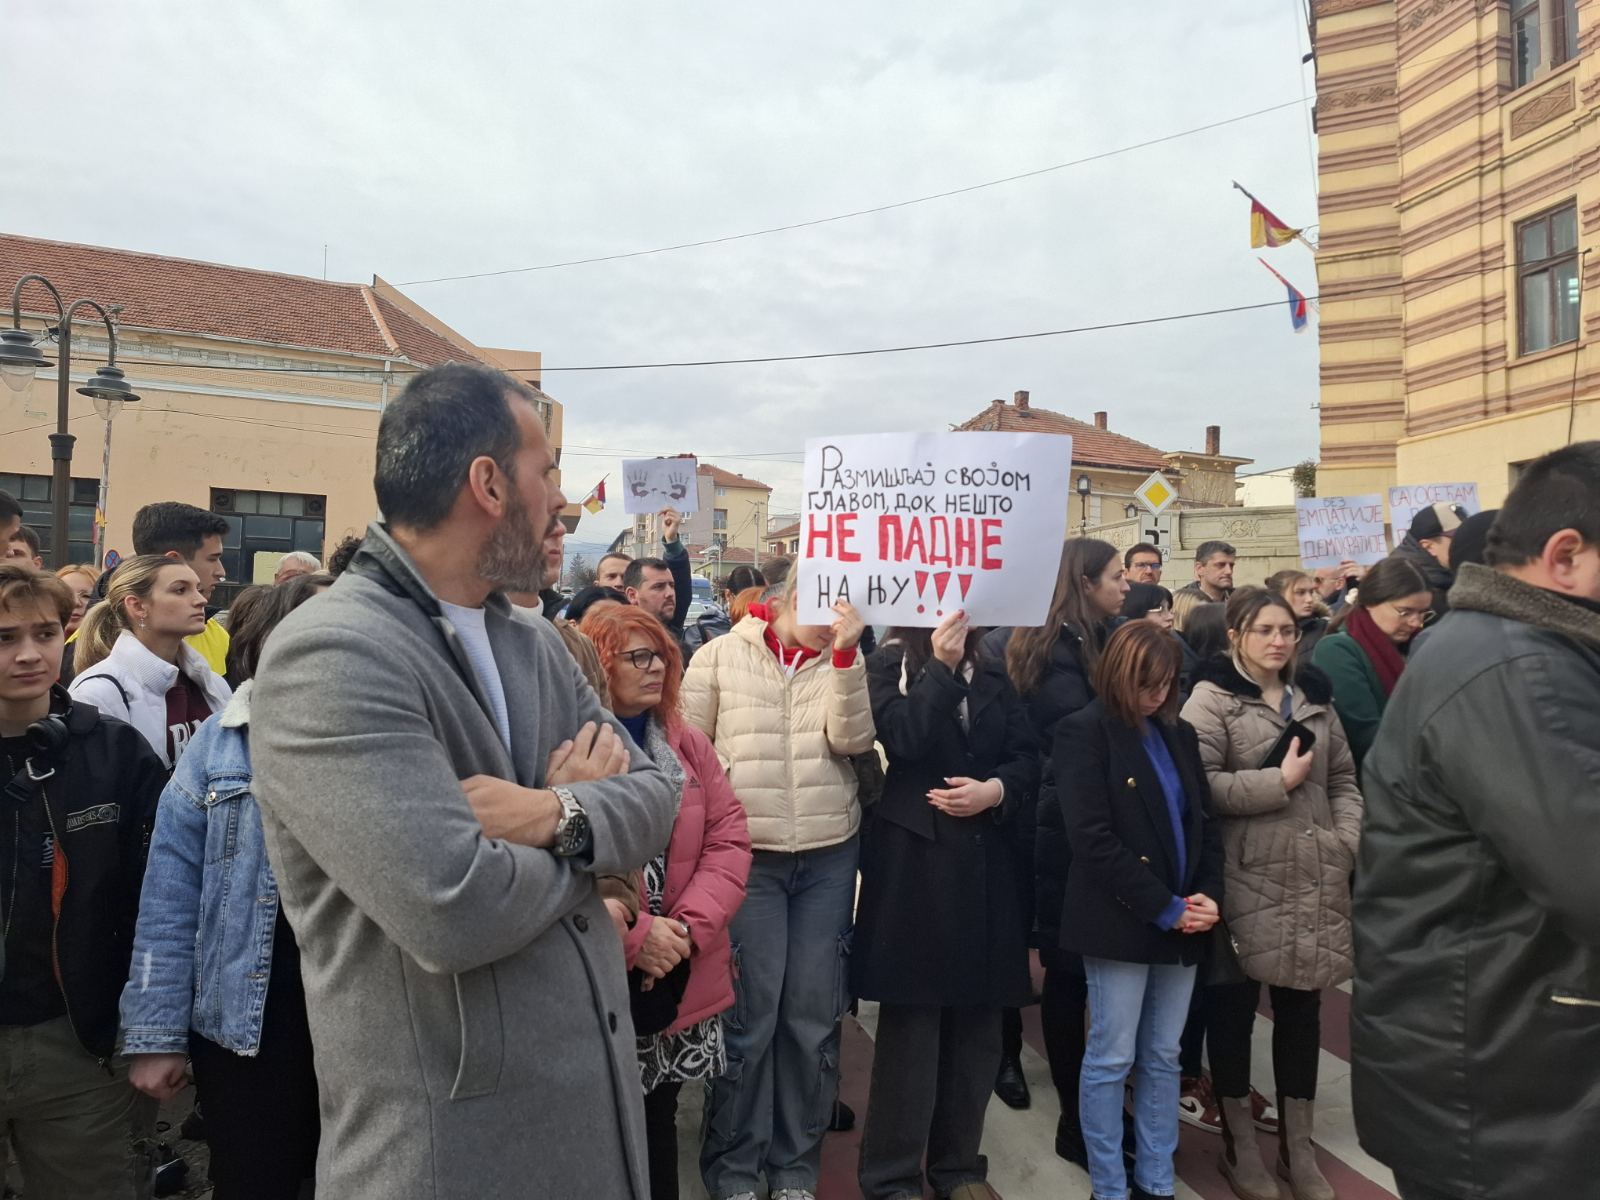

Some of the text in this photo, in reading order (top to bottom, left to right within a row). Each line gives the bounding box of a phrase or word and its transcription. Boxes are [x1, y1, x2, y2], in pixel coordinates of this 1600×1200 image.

[820, 445, 1030, 491] РАЗМИШЉАЈ СВОЈОМ
[808, 491, 1013, 515] ГЛАВОМ, ДОК НЕШТО
[1298, 505, 1384, 527] ЕМПАТИЈЕ
[806, 513, 1003, 570] НЕ ПАДНЕ
[1327, 524, 1359, 536] НЕМА
[817, 574, 850, 608] НА
